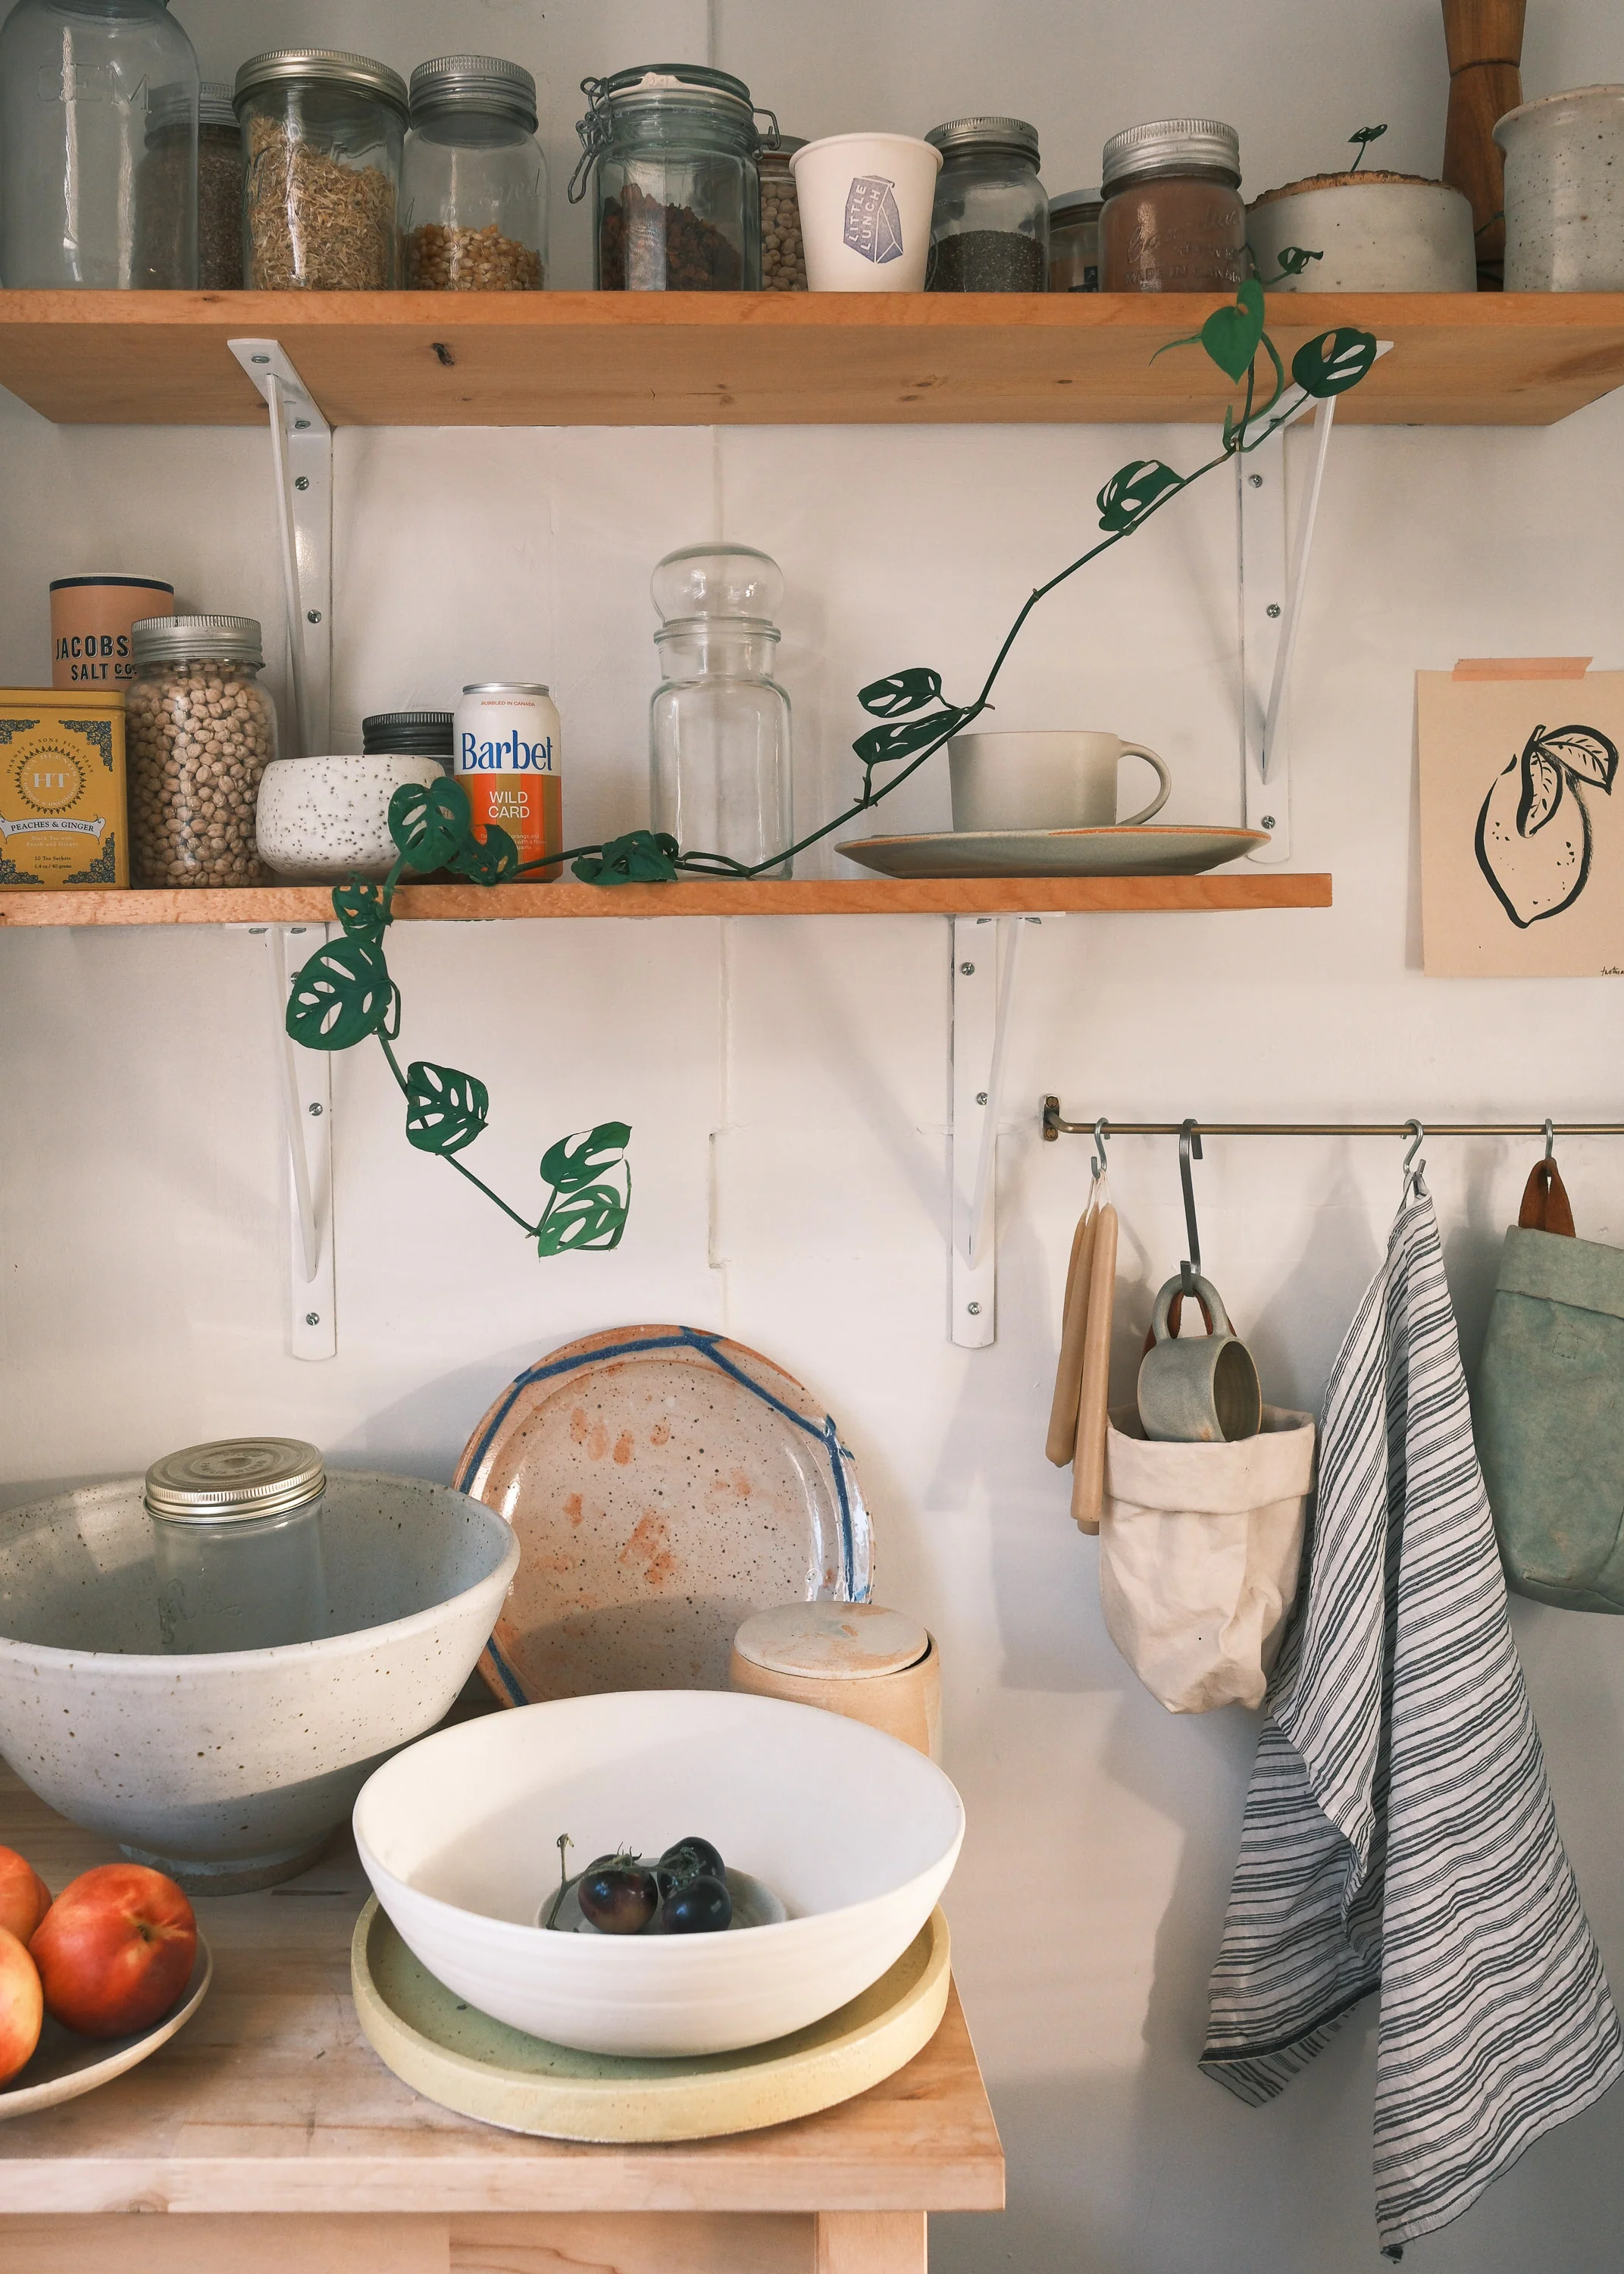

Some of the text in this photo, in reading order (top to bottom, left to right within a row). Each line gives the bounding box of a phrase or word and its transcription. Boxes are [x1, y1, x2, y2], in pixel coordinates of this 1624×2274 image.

[848, 184, 867, 242] LITTLE
[860, 190, 881, 251] LUNCH
[56, 635, 130, 661] JACOBS
[70, 663, 109, 681] SALT
[6, 745, 26, 774] HARNEY
[63, 740, 81, 753] FINE
[82, 754, 94, 773] TEAS
[462, 729, 553, 772] Barbet
[33, 772, 70, 788] HT
[489, 791, 528, 804] WILD
[487, 805, 530, 819] CARD
[11, 821, 50, 832] PEACHES
[61, 821, 95, 832] GINGER
